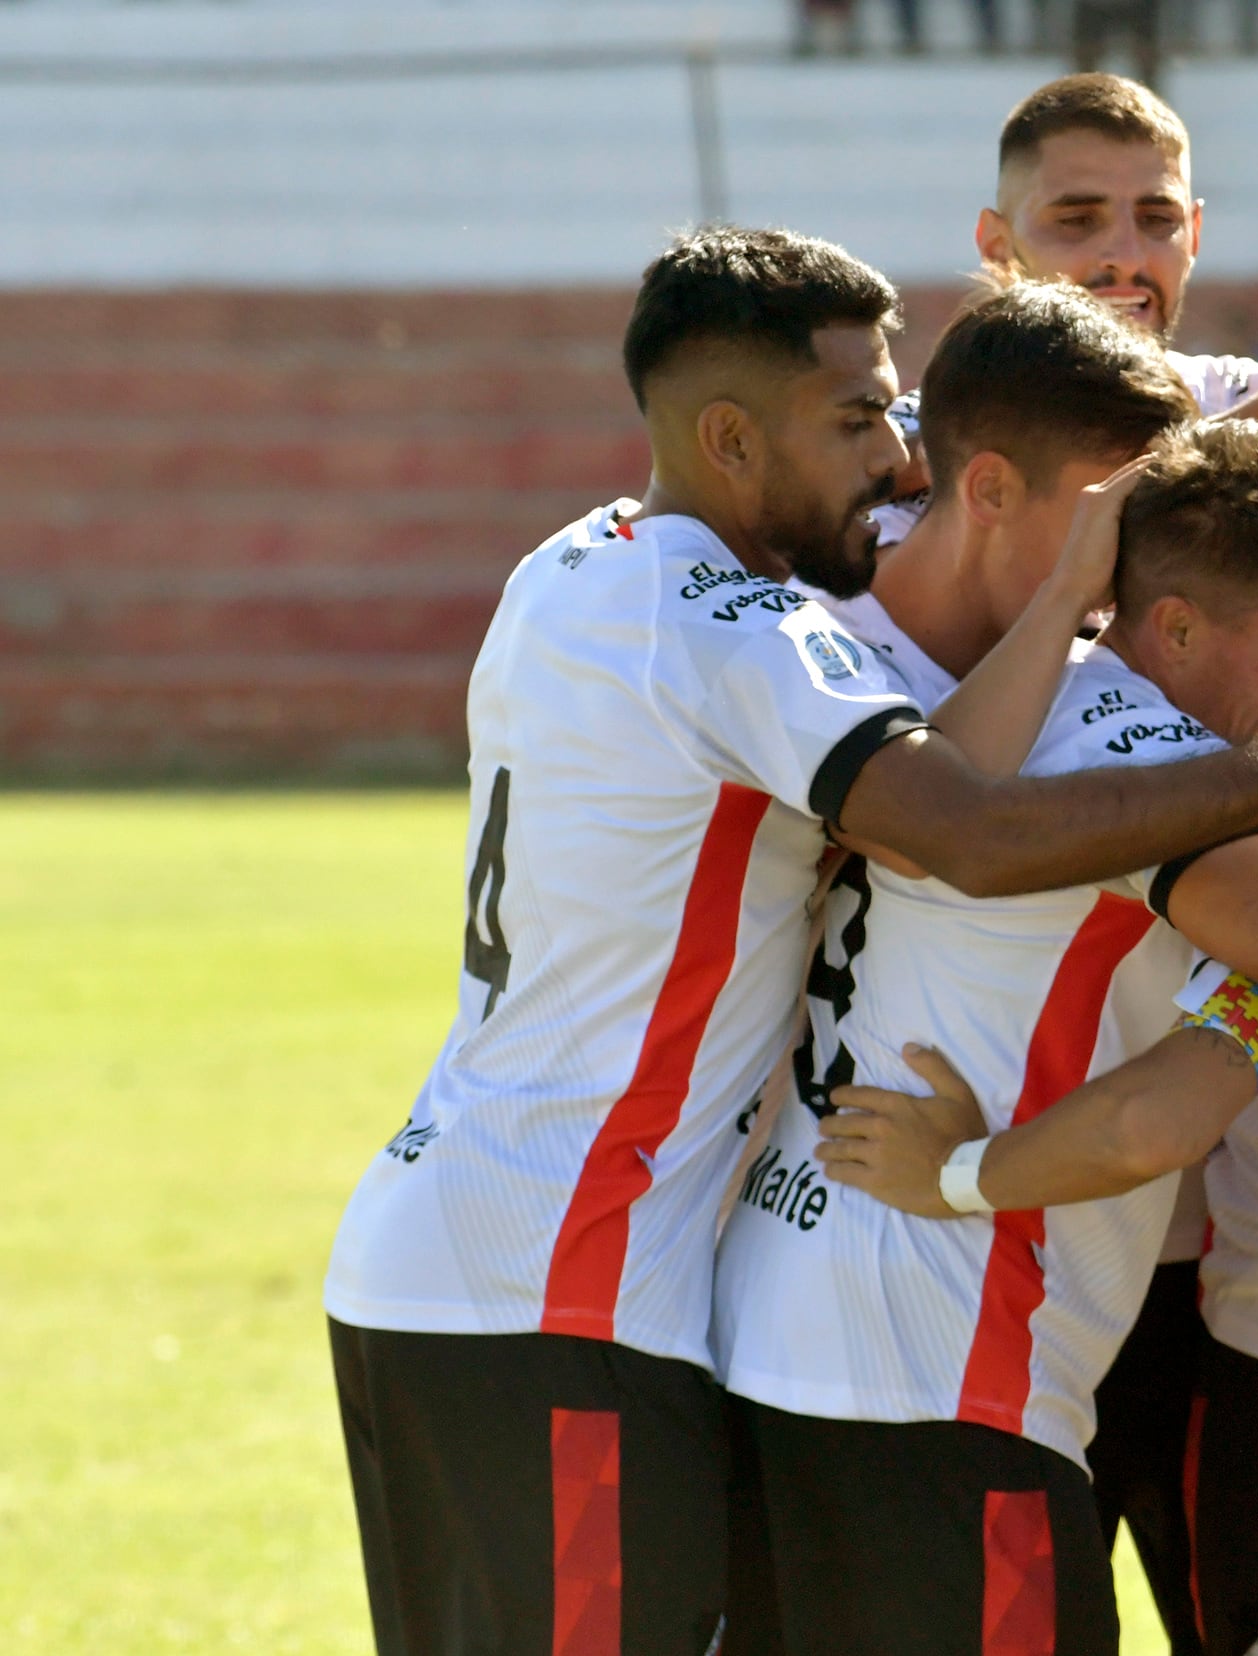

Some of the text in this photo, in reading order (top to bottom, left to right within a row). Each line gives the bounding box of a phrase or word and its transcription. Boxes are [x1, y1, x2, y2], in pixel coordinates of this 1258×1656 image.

[689, 561, 717, 582] El
[464, 766, 512, 1025] 4
[739, 1146, 828, 1231] Malte
